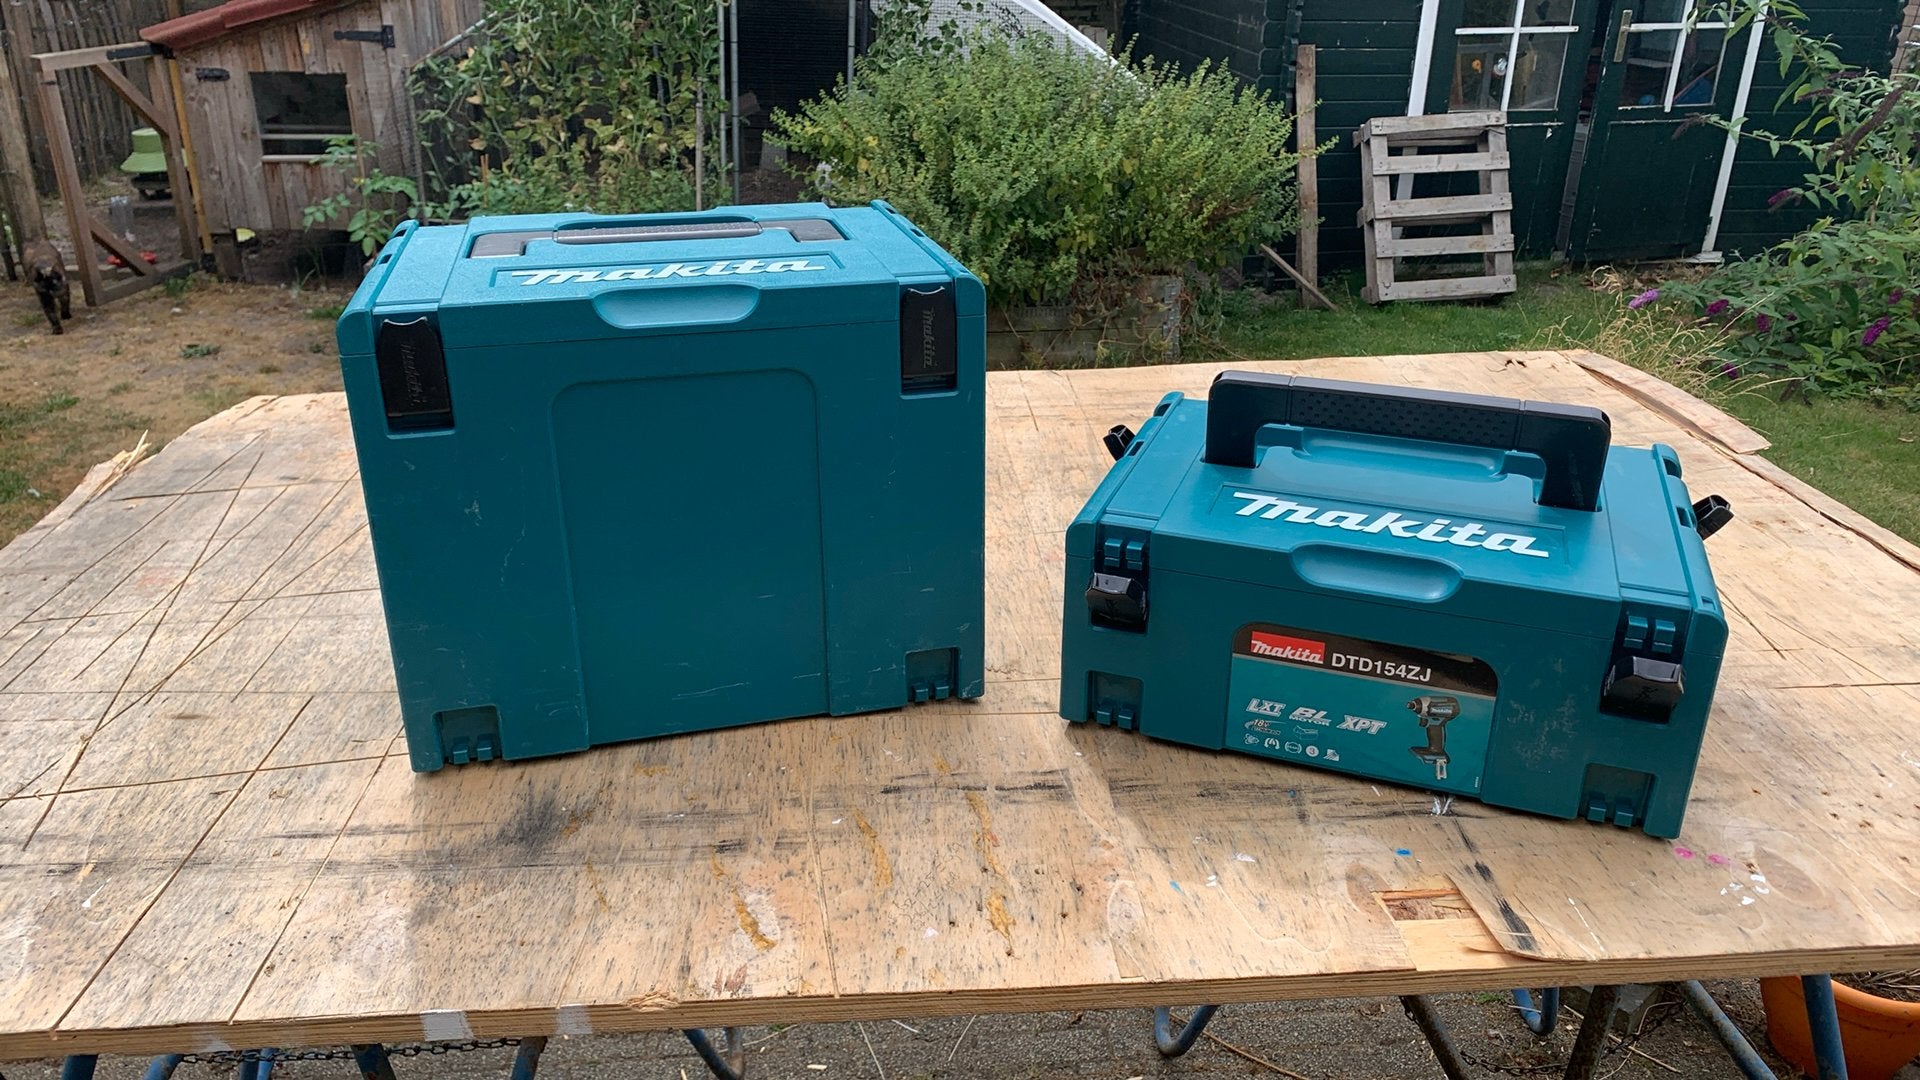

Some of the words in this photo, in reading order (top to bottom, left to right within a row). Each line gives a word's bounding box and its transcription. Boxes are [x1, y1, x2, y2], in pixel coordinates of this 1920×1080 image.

[1331, 652, 1432, 683] DTD154ZJ
[1246, 698, 1286, 717] LXT
[1290, 706, 1331, 722] BL
[1336, 714, 1387, 735] XPT
